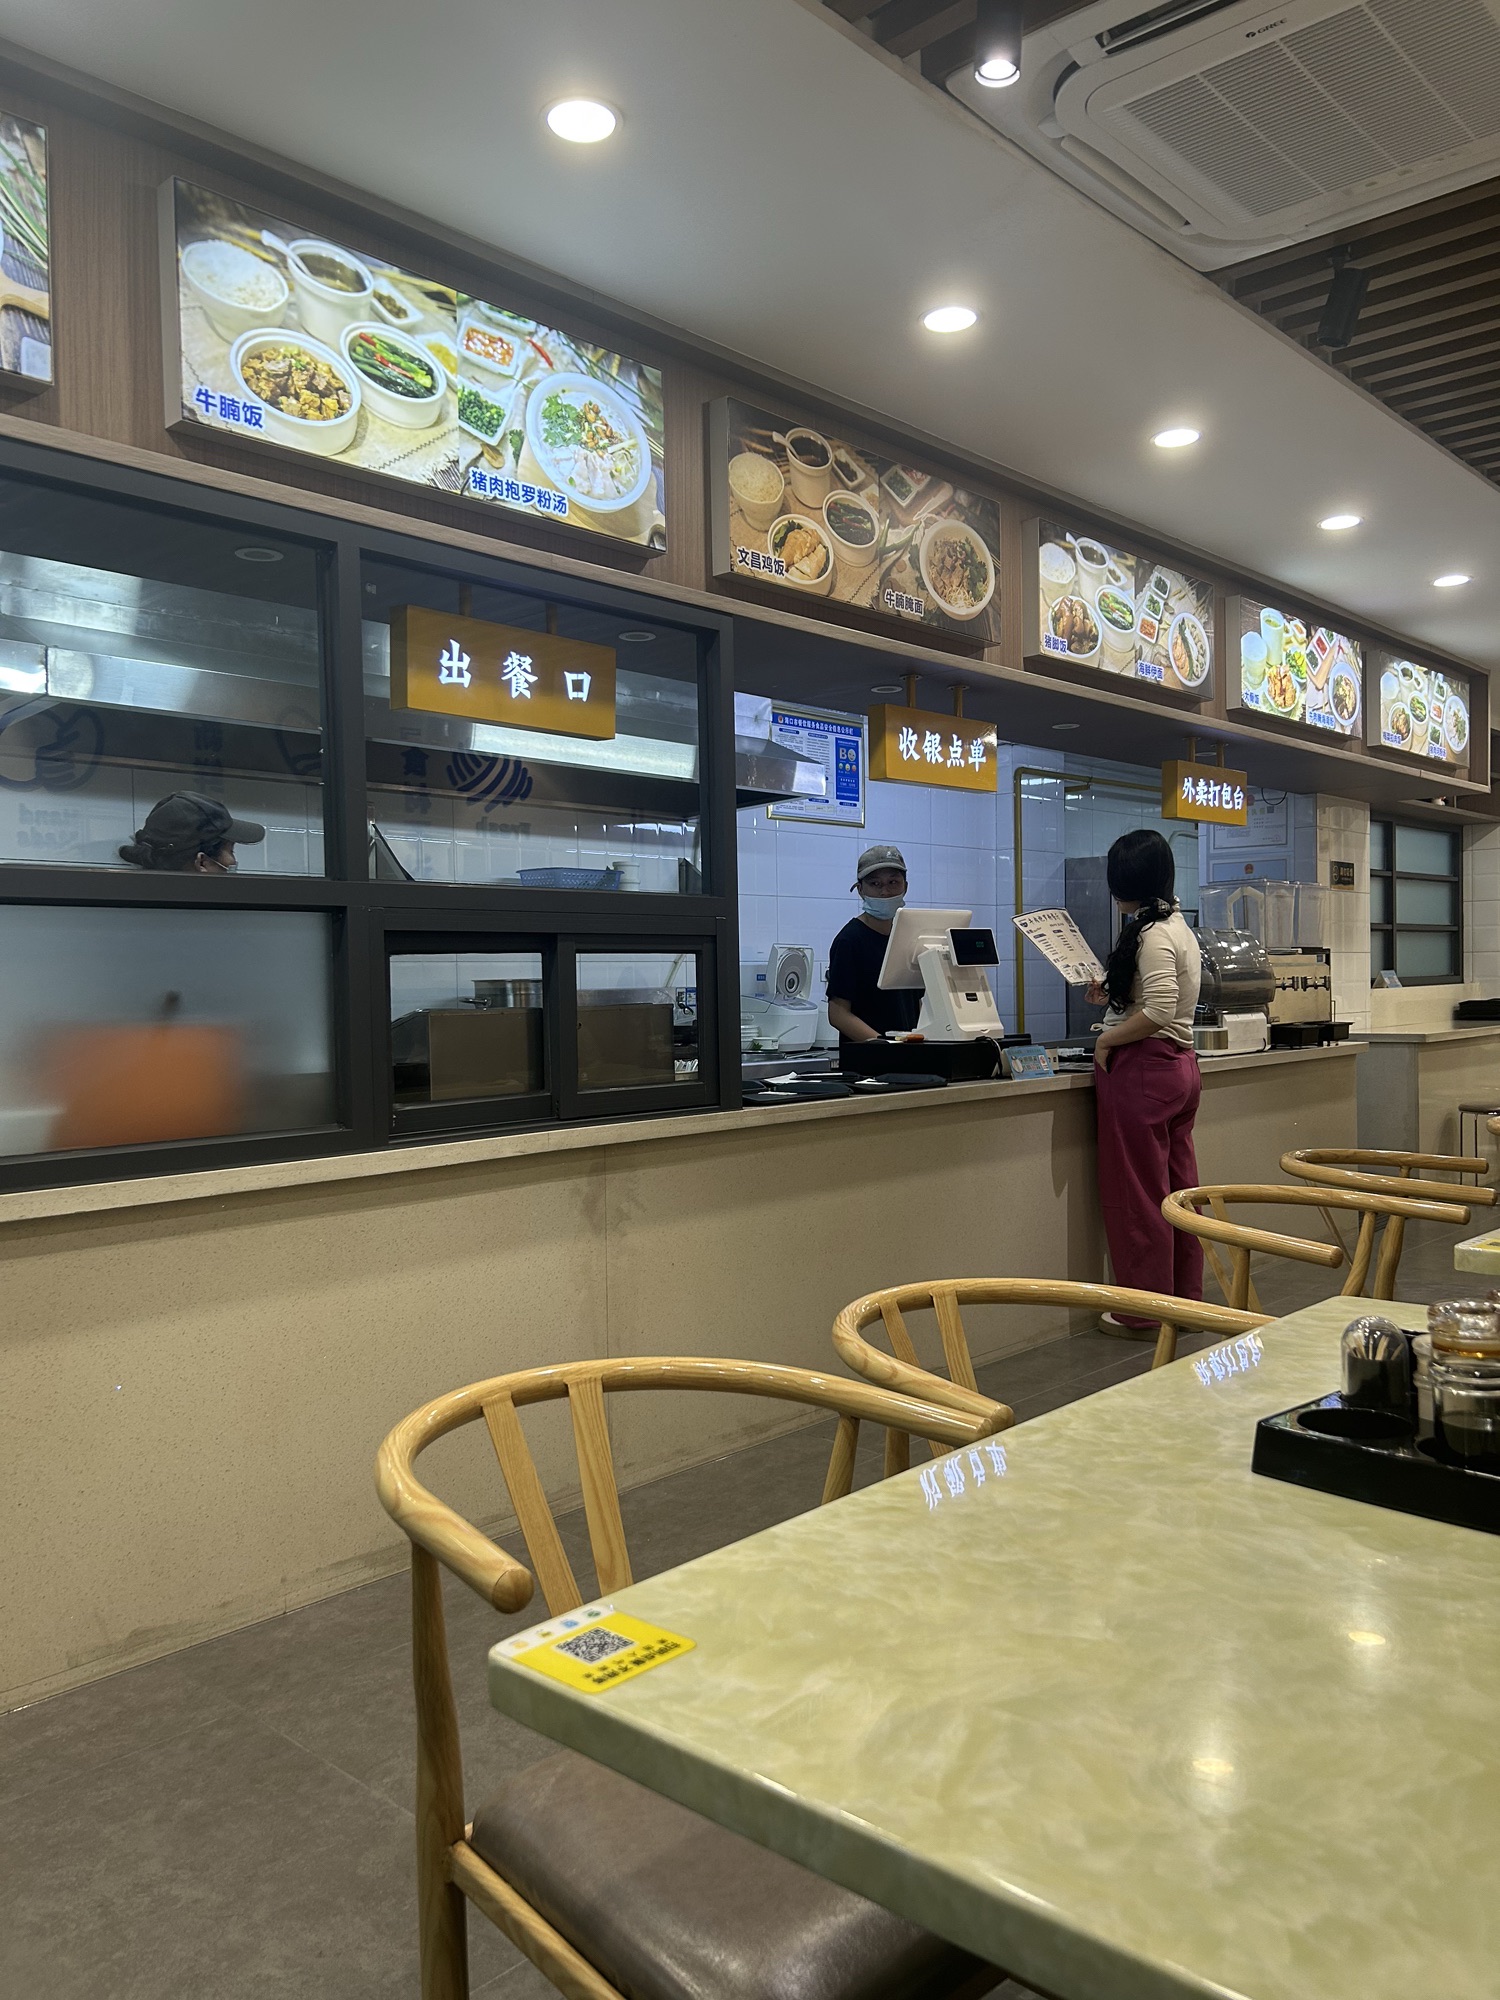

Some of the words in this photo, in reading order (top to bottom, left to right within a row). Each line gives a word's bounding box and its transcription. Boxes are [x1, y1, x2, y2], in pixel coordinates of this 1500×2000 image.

[195, 387, 264, 429] 牛腩饭
[470, 468, 568, 515] 猪肉抱罗粉汤
[737, 547, 786, 577] 文昌鸡饭
[438, 638, 592, 703] 出餐口
[898, 726, 987, 772] 收银点单
[1181, 776, 1245, 810] 外卖打包台
